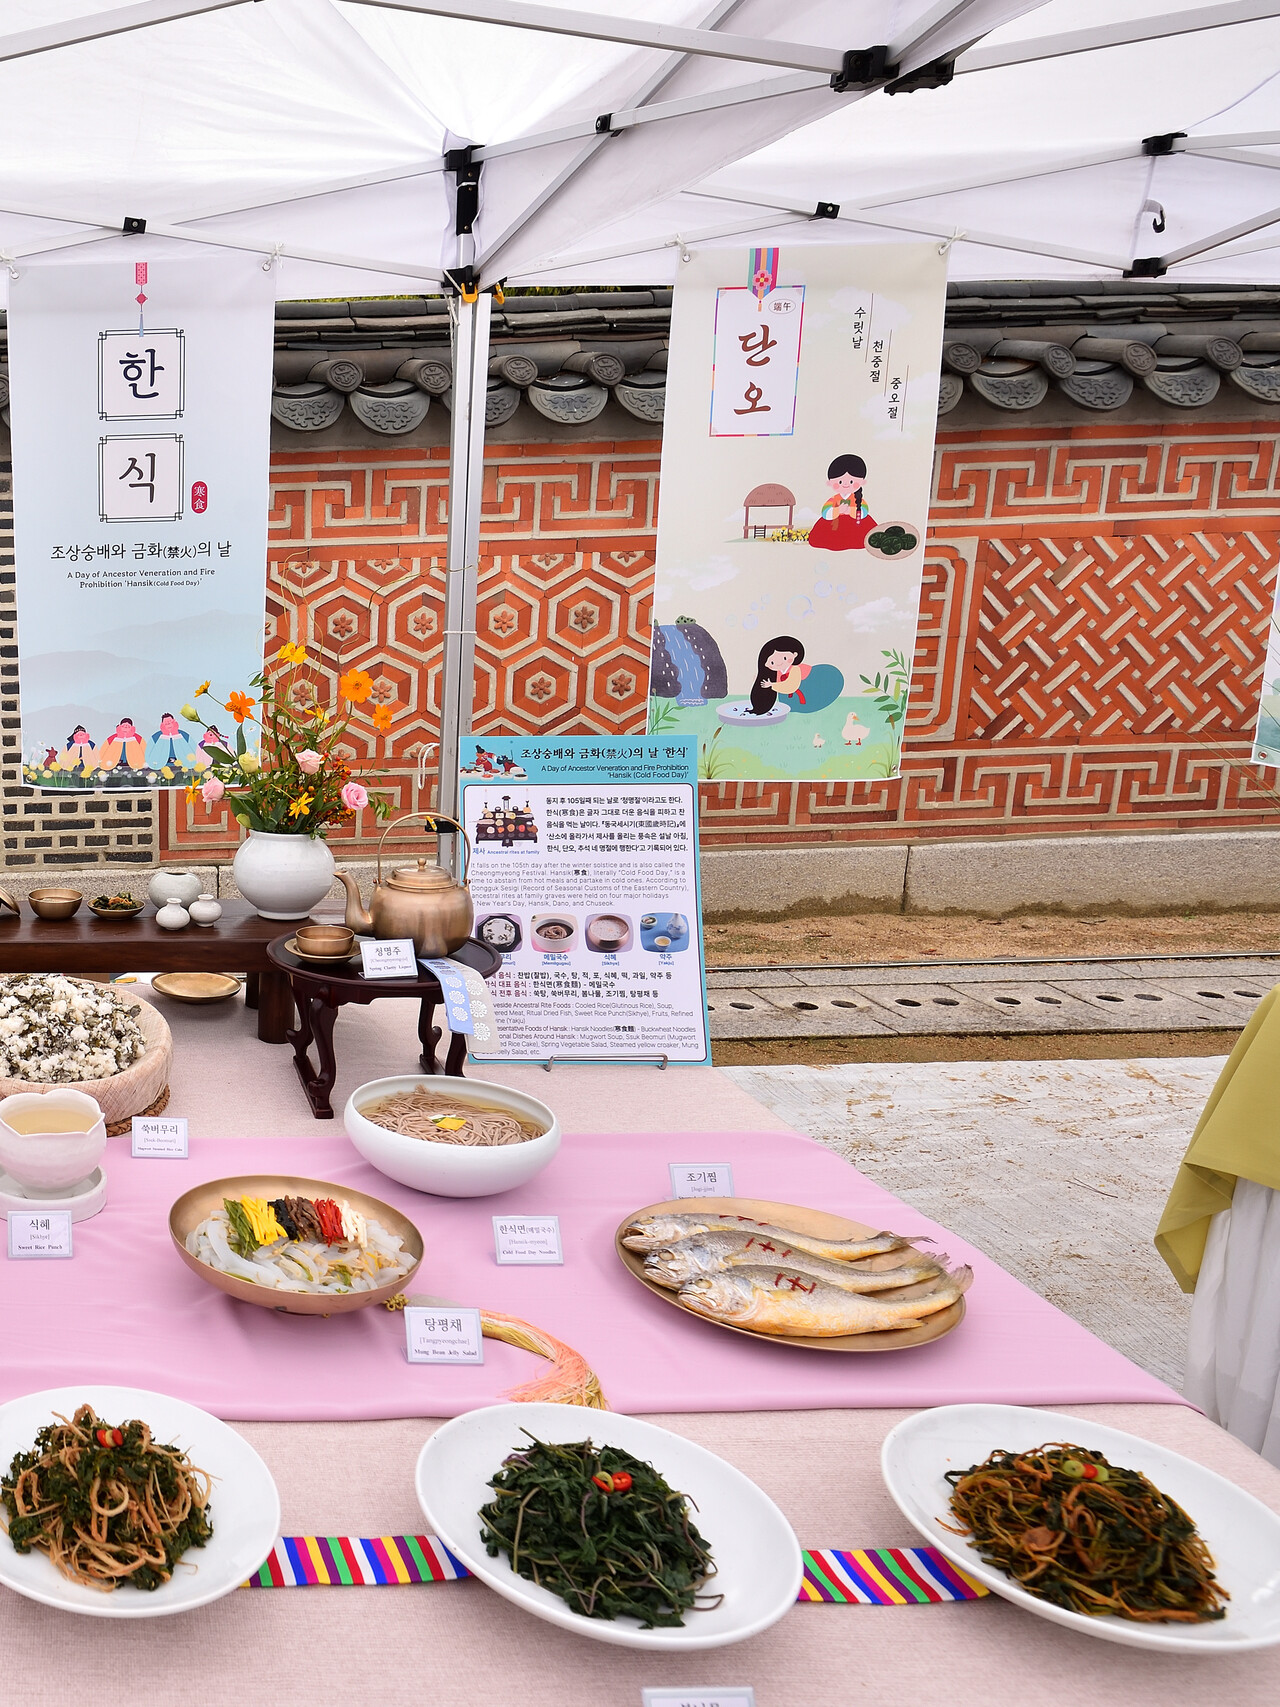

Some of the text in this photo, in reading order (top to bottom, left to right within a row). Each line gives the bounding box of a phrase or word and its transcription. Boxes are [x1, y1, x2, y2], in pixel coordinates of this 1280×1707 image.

[773, 302, 791, 311] 端午
[852, 307, 866, 349] 수릿날
[870, 340, 883, 383] 천중절
[733, 324, 778, 415] 단오
[888, 378, 901, 419] 중오절
[194, 485, 205, 510] 寒食
[51, 541, 232, 561] 조상숭배와 금화(禁火)의 날
[103, 570, 136, 578] Ancestor
[139, 569, 181, 577] Veneration
[521, 747, 659, 759] 조상숭배와 금화(禁火)의 날
[375, 946, 401, 956] 청명주
[572, 972, 580, 980] 탕,
[582, 972, 590, 980] 적,
[593, 972, 601, 980] 포,
[604, 972, 619, 980] 식혜,
[621, 972, 630, 980] 떡,
[633, 972, 648, 980] 과일,
[650, 972, 663, 980] 약주
[666, 972, 672, 980] 등
[582, 990, 603, 998] 봄나물,
[606, 990, 627, 998] 조기찜,
[630, 990, 650, 998] 탕평채
[653, 990, 658, 998] 등
[141, 1124, 177, 1134] 쑥버무리
[687, 1172, 716, 1182] 조기찜
[30, 1219, 50, 1230] 식혜
[425, 1318, 461, 1332] 탕평채
